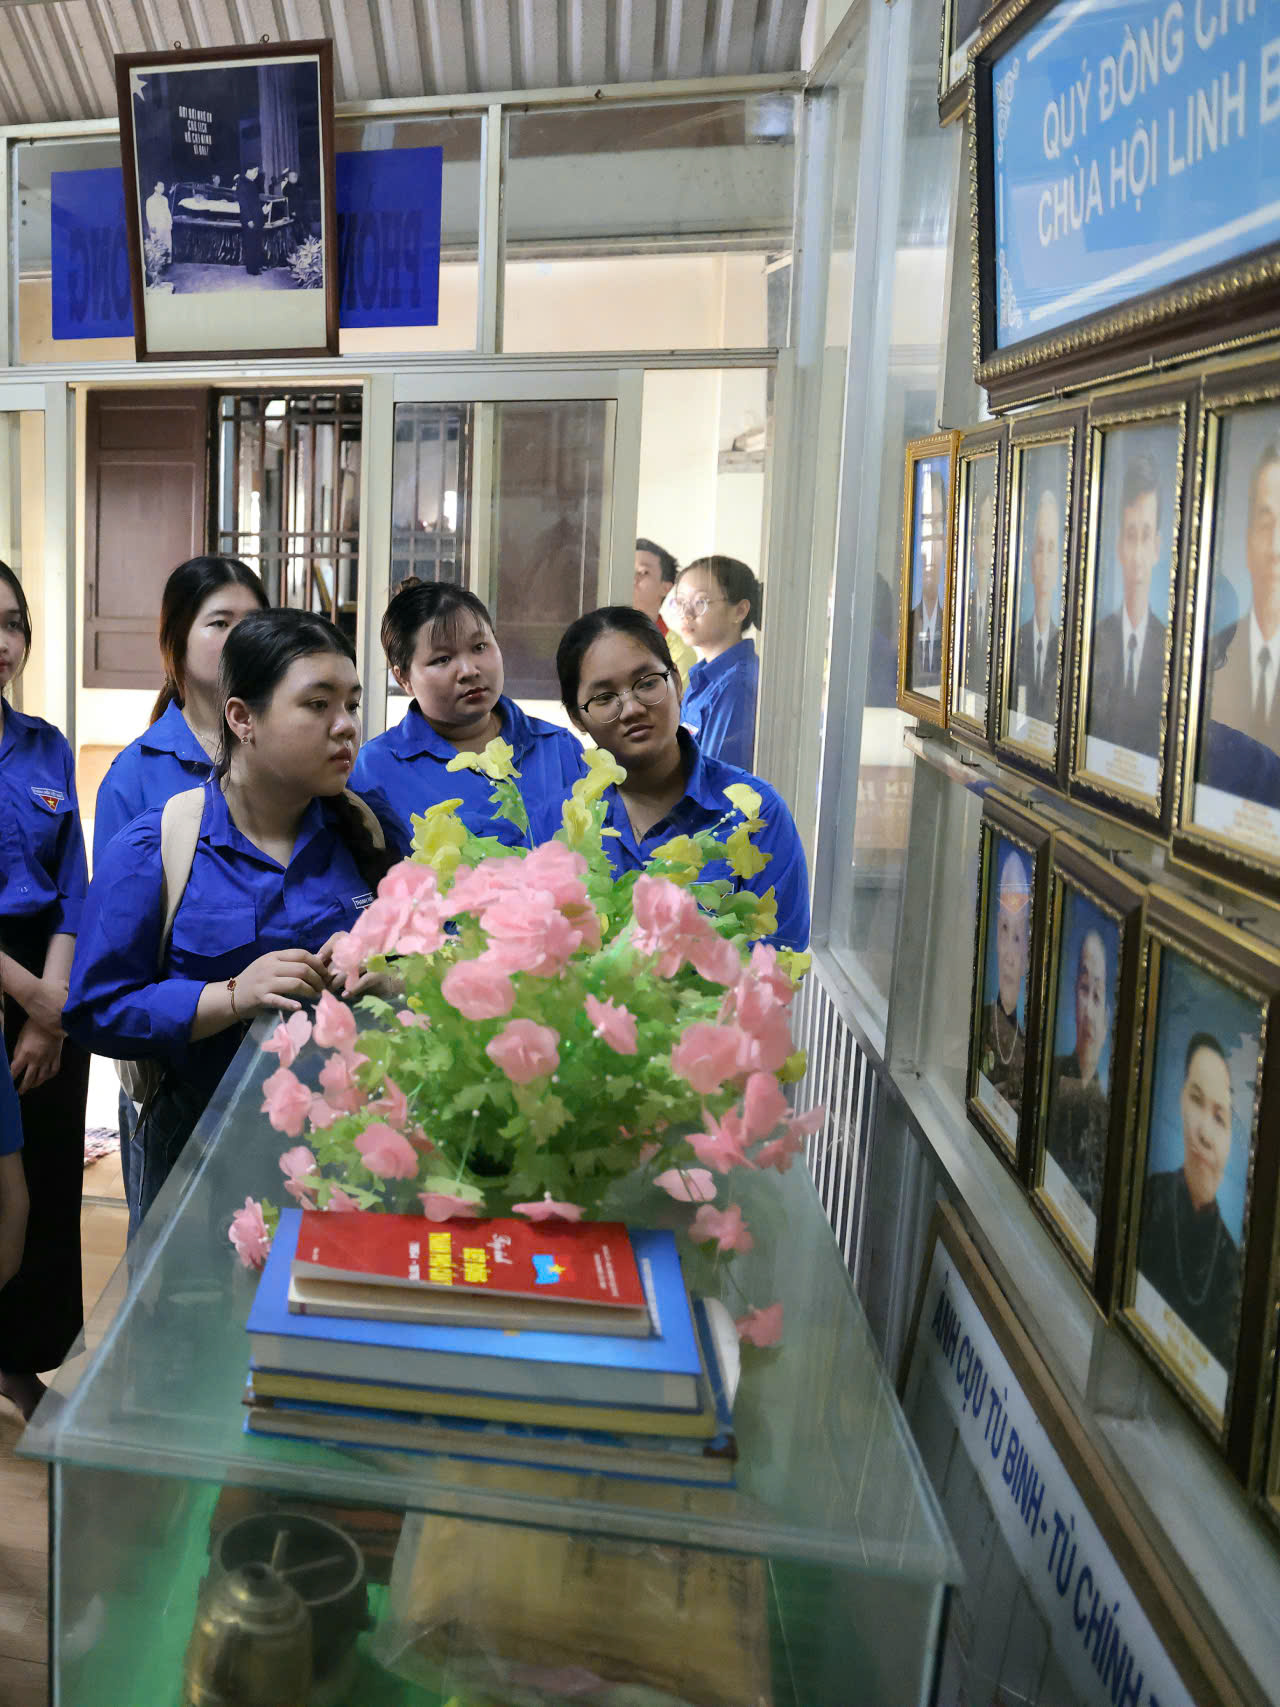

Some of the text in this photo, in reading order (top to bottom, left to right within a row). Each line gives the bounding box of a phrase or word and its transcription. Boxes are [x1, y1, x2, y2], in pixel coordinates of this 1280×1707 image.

[1037, 154, 1103, 248] CHÙA
[1110, 118, 1158, 213] HỘI
[1168, 61, 1246, 177] LINH
[1042, 58, 1093, 161] QUÝ
[931, 1271, 961, 1368] ẢNH
[955, 1334, 988, 1419] CỰU
[984, 1387, 1009, 1460] TÙ
[1001, 1430, 1046, 1537] BINH
[1046, 1513, 1078, 1597] TÙ
[1072, 1565, 1144, 1707] CHÍNH
